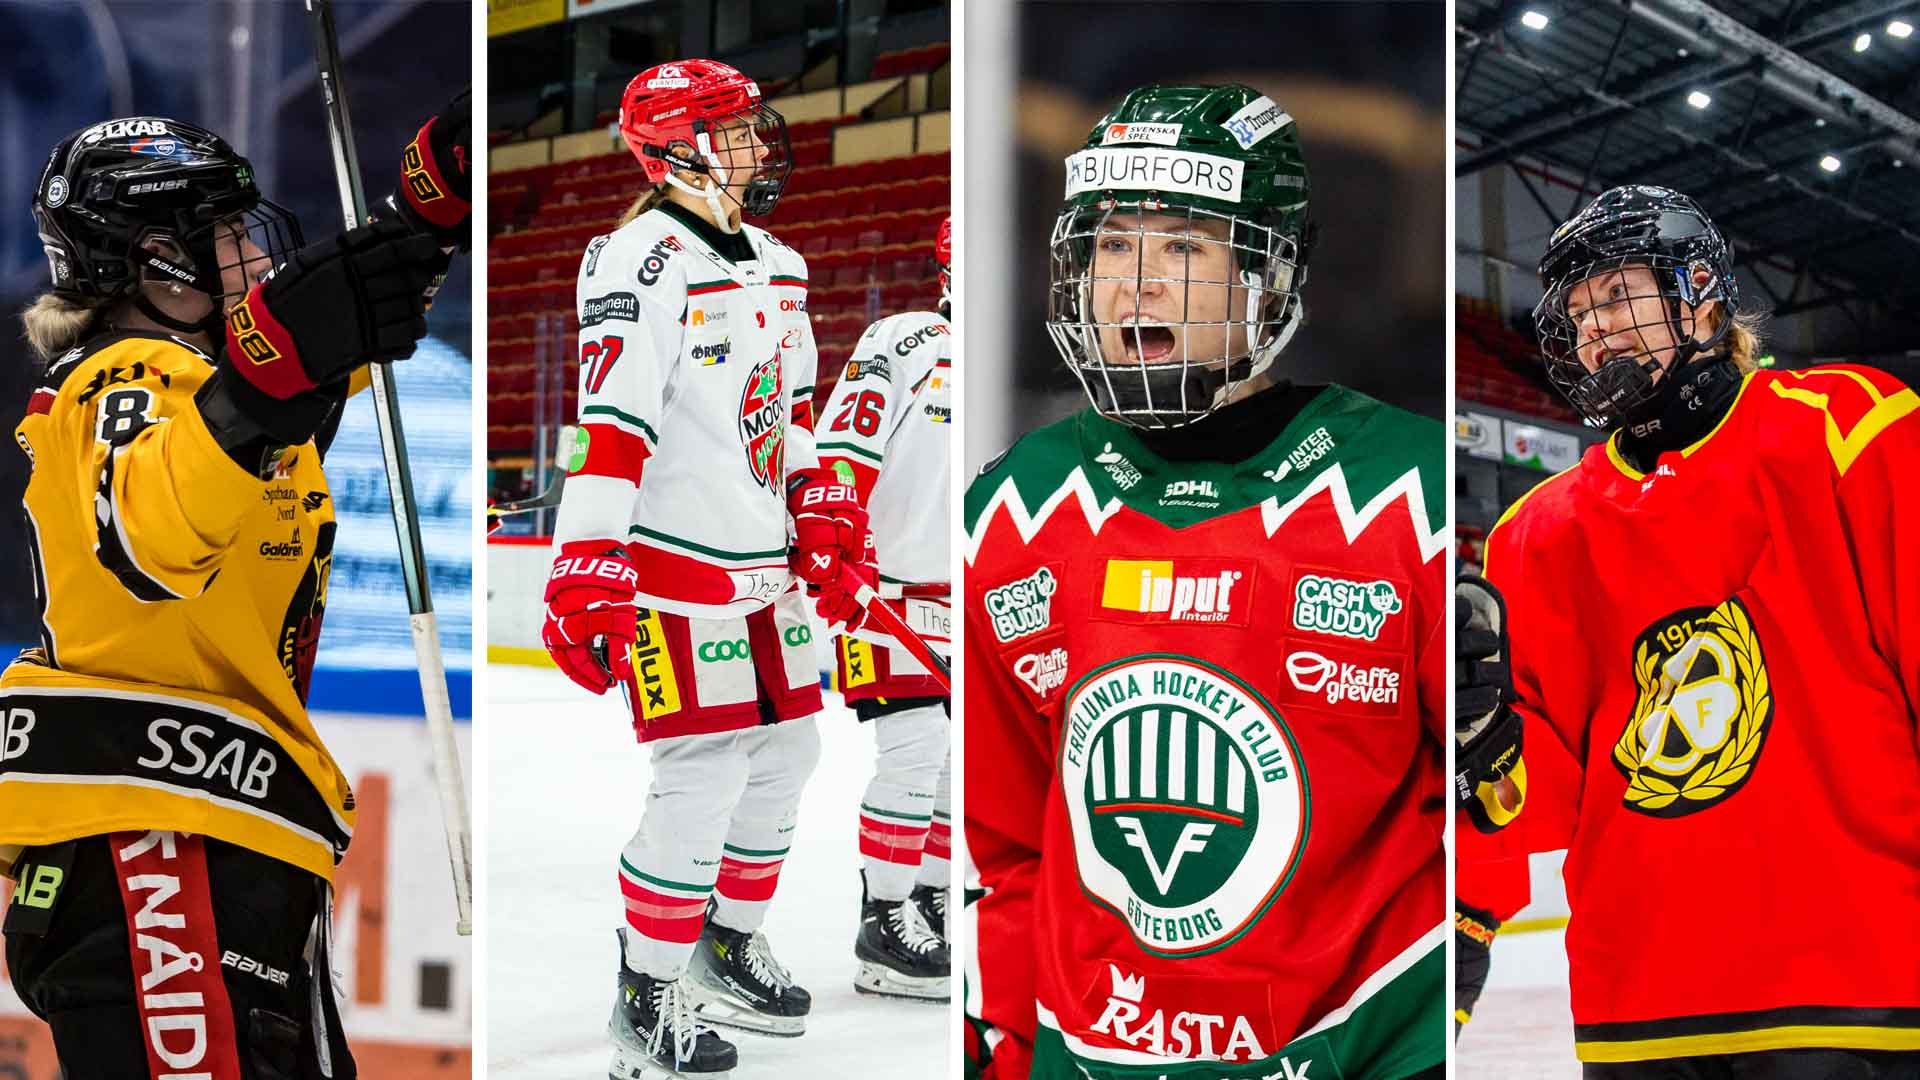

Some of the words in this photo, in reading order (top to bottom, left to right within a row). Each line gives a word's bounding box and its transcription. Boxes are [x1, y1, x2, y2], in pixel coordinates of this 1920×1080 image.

[106, 121, 166, 137] LKAB
[1127, 132, 1151, 141] SPEL
[1130, 125, 1177, 136] SVENSKA
[128, 178, 188, 196] BAUER
[1084, 155, 1234, 192] BJURFORS
[148, 257, 197, 284] BAUER
[580, 335, 624, 396] 77
[830, 388, 886, 438] 26
[1631, 419, 1663, 439] ER
[1288, 426, 1331, 465] INTER
[1295, 436, 1336, 473] SPORT
[1104, 464, 1134, 492] SPORT
[1166, 499, 1220, 510] BAUER
[988, 579, 1039, 616] CASH
[1138, 568, 1234, 621] input
[1301, 580, 1366, 612] CASH
[995, 602, 1050, 640] BUDDY
[1181, 610, 1229, 622] interiör
[1299, 604, 1382, 638] BUDDY
[698, 638, 752, 664] coo
[1656, 617, 1708, 654] 191
[1340, 662, 1400, 688] Kaffe
[1326, 681, 1398, 705] greven
[1068, 673, 1143, 768] FRÖLUNDA
[1153, 669, 1246, 722] HOCKEY
[1240, 718, 1289, 784] CLUB
[137, 718, 278, 800] SSAB
[1127, 895, 1224, 944] GÖTEBORG
[220, 949, 290, 988] BAUER
[1089, 996, 1269, 1062] RASTA
